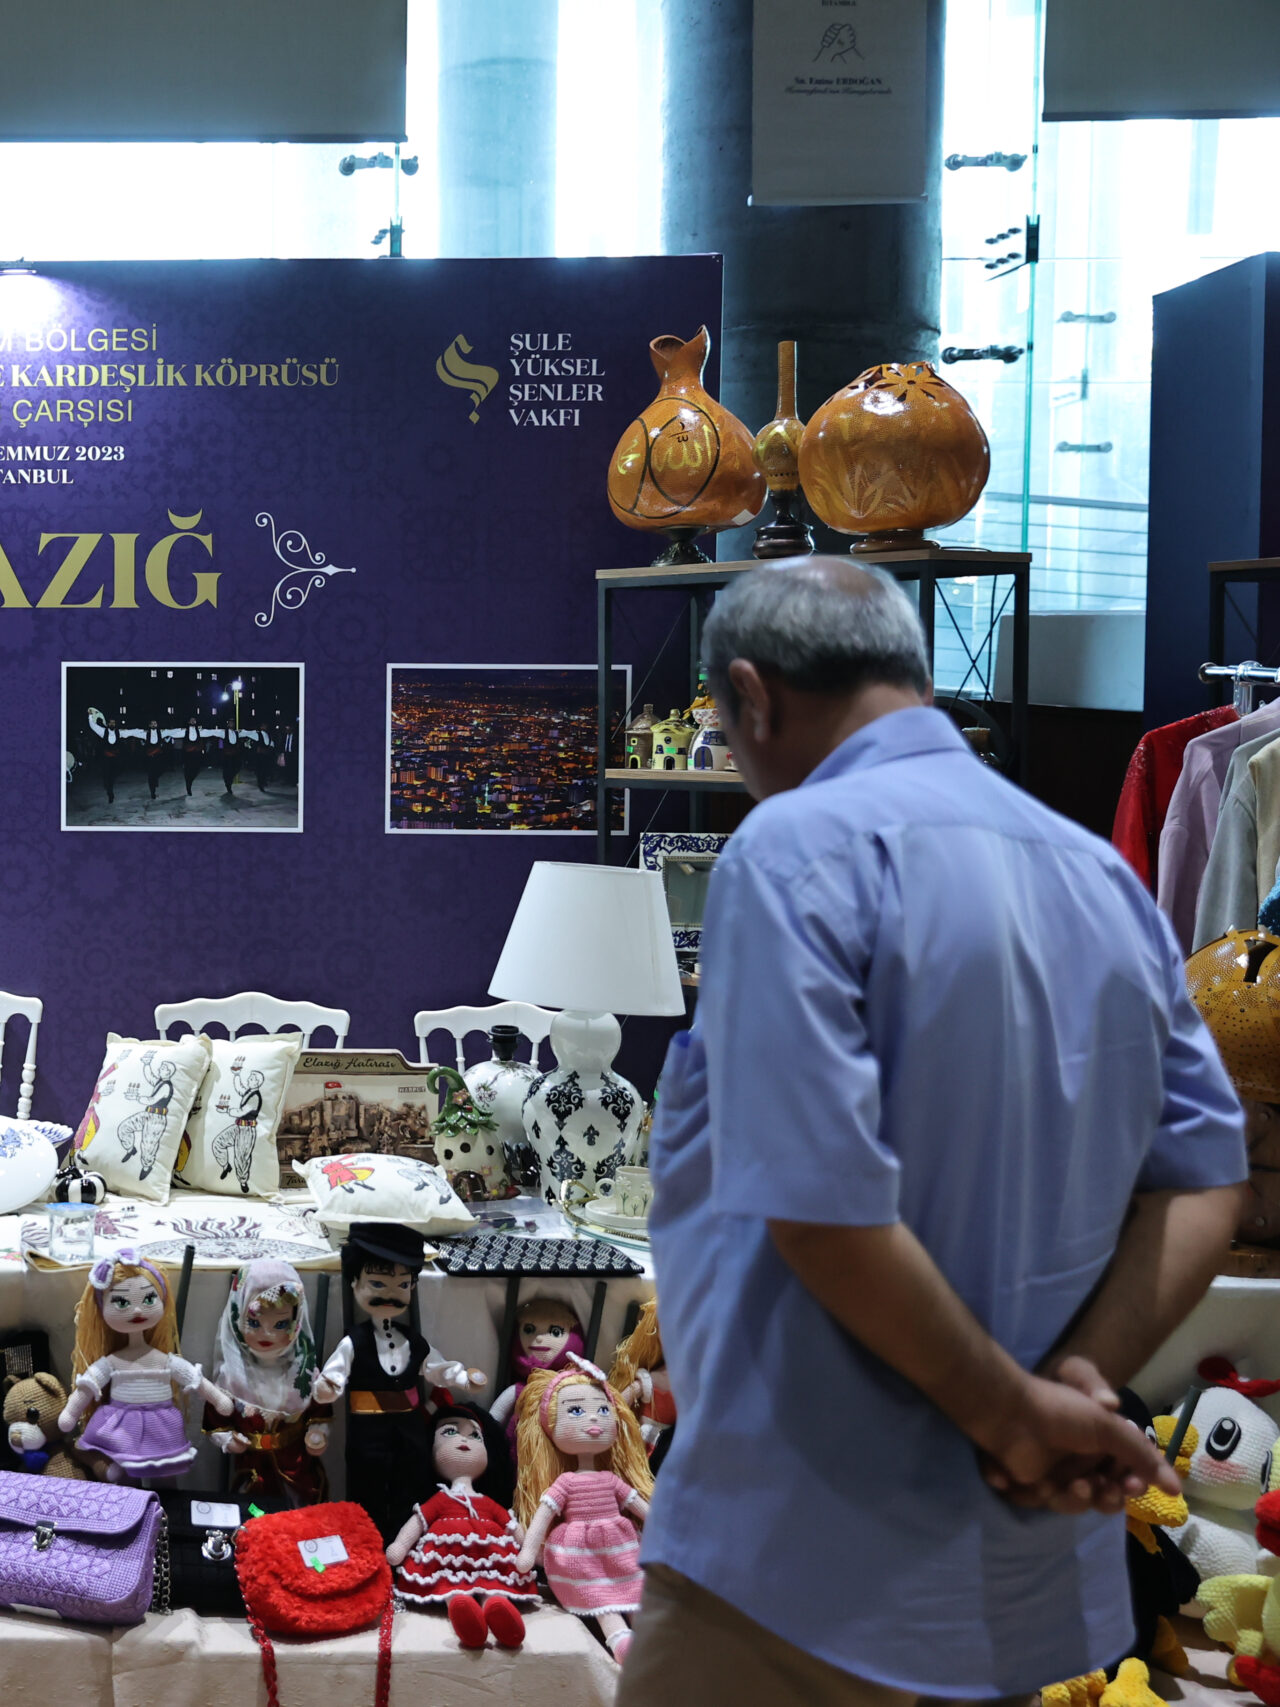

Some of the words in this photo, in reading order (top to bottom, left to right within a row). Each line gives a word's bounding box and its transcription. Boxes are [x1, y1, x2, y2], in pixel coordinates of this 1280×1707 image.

[25, 323, 157, 352] BÖLGESİ
[510, 333, 572, 356] ŞULE
[11, 357, 187, 393] KARDEŞLİK
[195, 357, 340, 387] KÖPRÜSÜ
[509, 353, 606, 376] YÜKSEL
[509, 383, 604, 406] ŞENLER
[12, 399, 133, 429] ÇARŞISI
[509, 408, 580, 427] VAKFI
[75, 446, 125, 461] 2023
[303, 1057, 341, 1069] Elazığ
[345, 1057, 396, 1070] Hatırası
